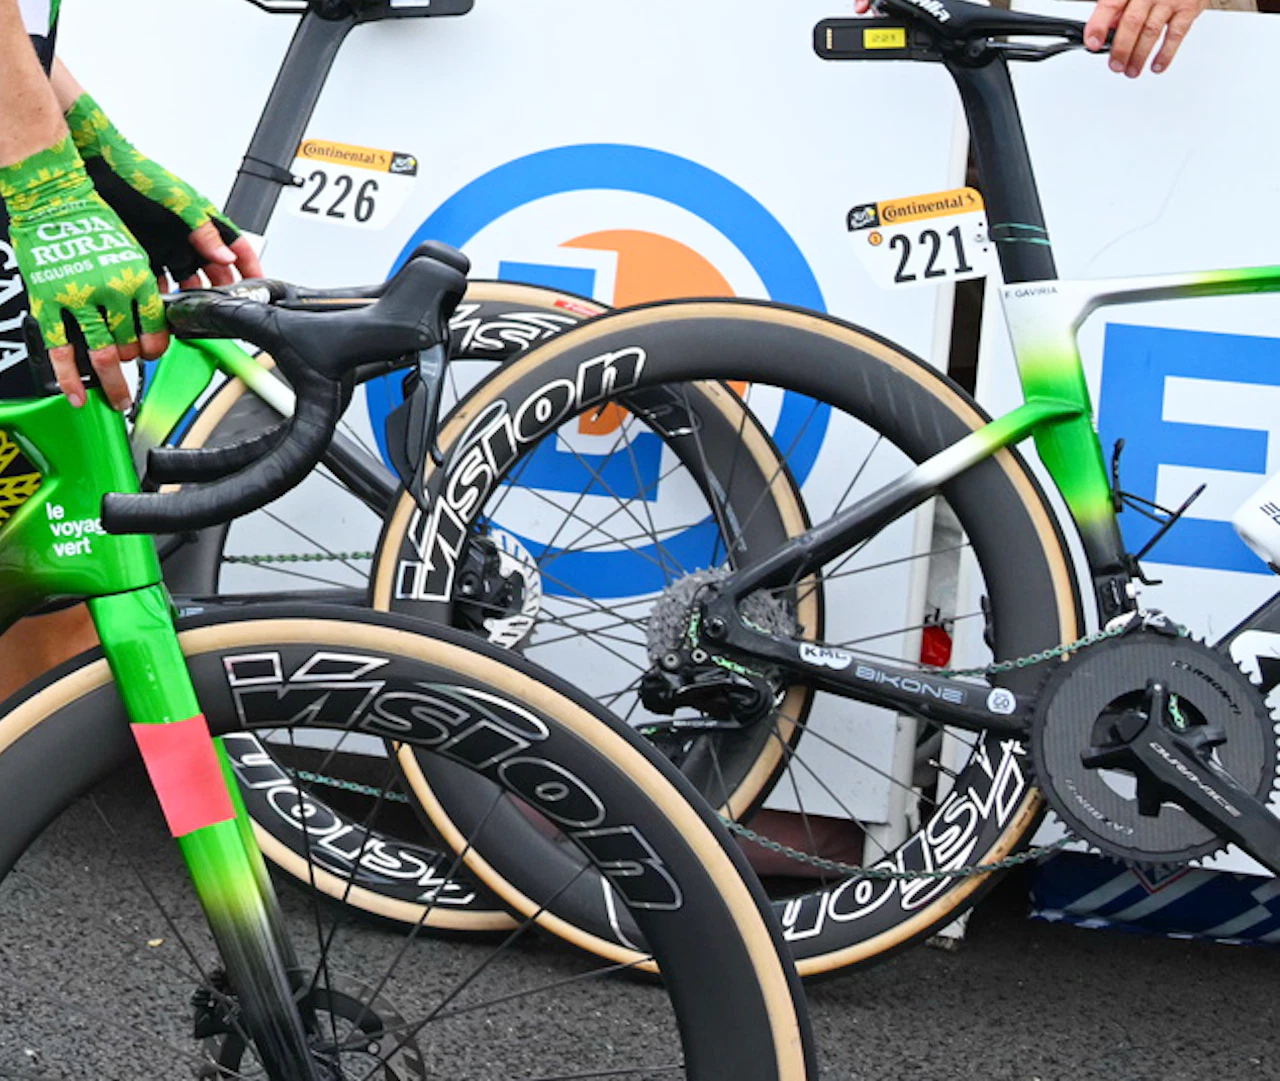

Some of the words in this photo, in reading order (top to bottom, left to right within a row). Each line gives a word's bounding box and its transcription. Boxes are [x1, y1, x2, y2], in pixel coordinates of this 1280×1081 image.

[303, 142, 376, 164] Continental
[300, 169, 379, 222] 226
[882, 195, 964, 222] Continental
[37, 216, 115, 241] CAJA
[889, 225, 973, 284] 221
[30, 260, 94, 285] SEGUROS
[1015, 285, 1059, 298] GAVIRIA
[396, 346, 646, 603] Vision
[46, 503, 65, 521] le
[50, 519, 108, 538] voyag
[53, 539, 92, 557] vert
[855, 663, 965, 706] BIKONE
[223, 652, 683, 910] Vision
